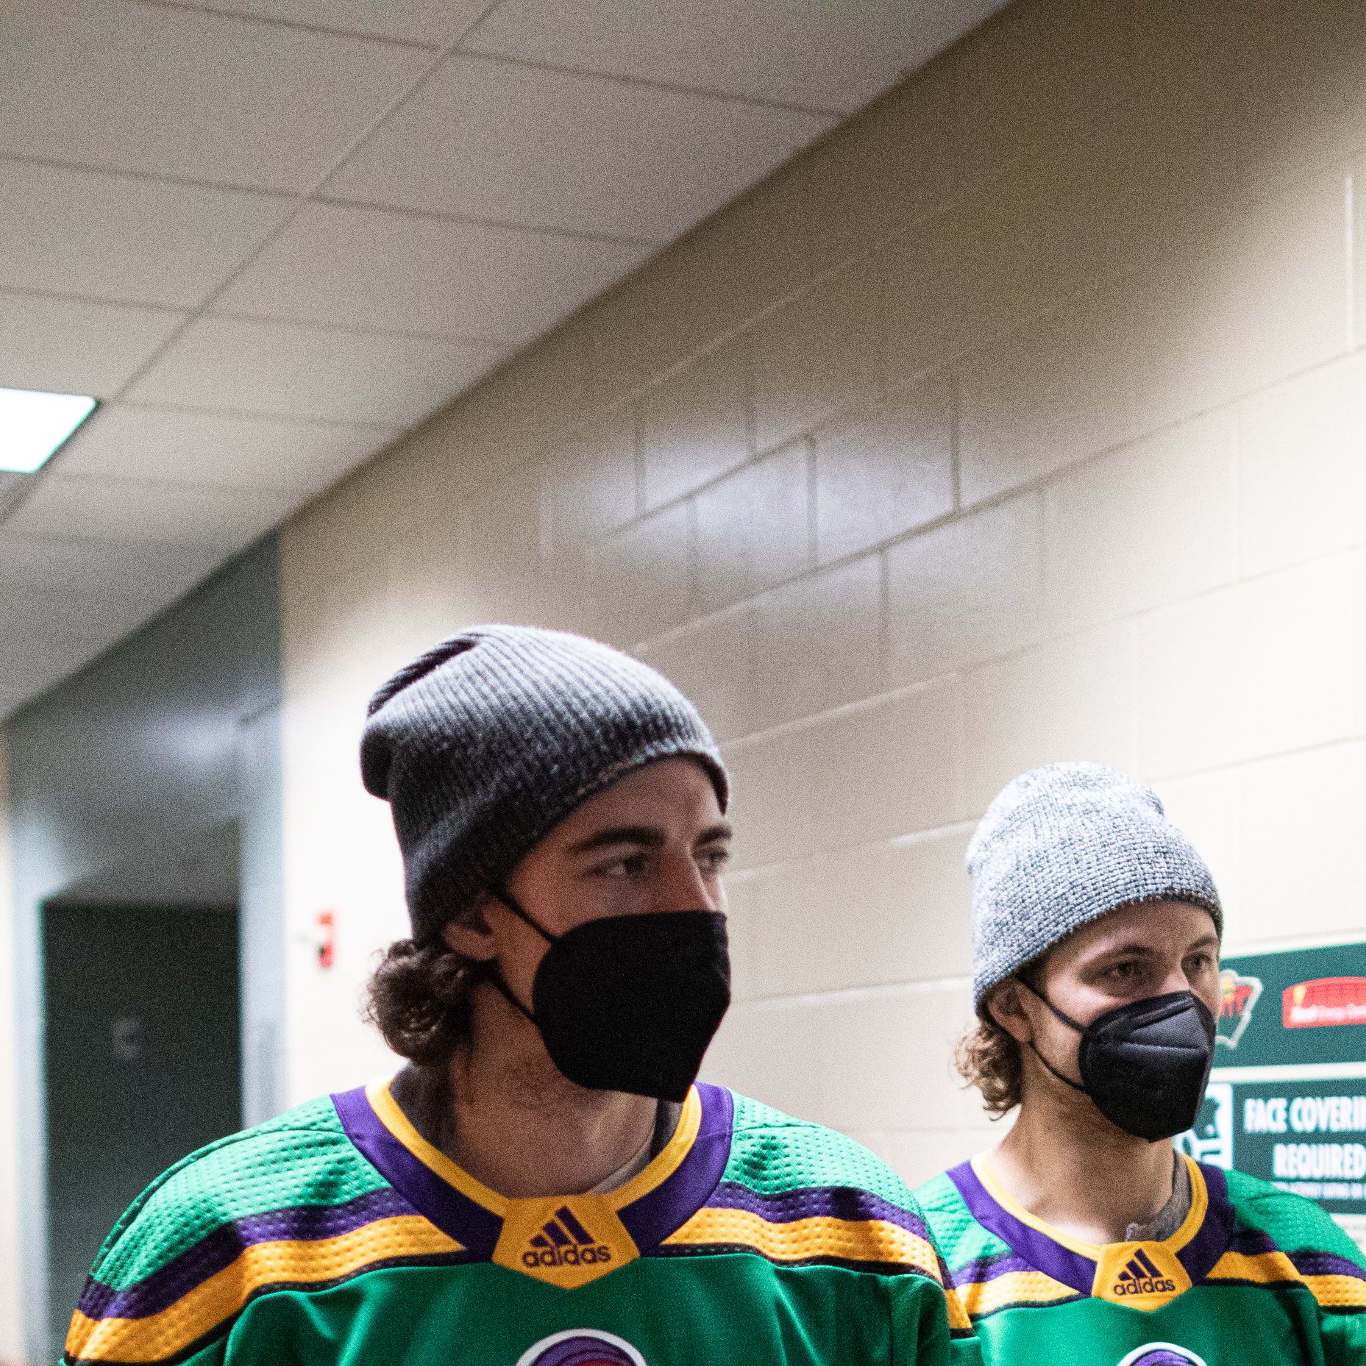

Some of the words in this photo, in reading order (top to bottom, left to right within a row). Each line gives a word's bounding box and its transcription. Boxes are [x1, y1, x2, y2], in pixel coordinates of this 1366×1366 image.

[1244, 1098, 1287, 1133] FACE
[522, 1244, 611, 1268] adidas
[1113, 1276, 1175, 1295] adidas
